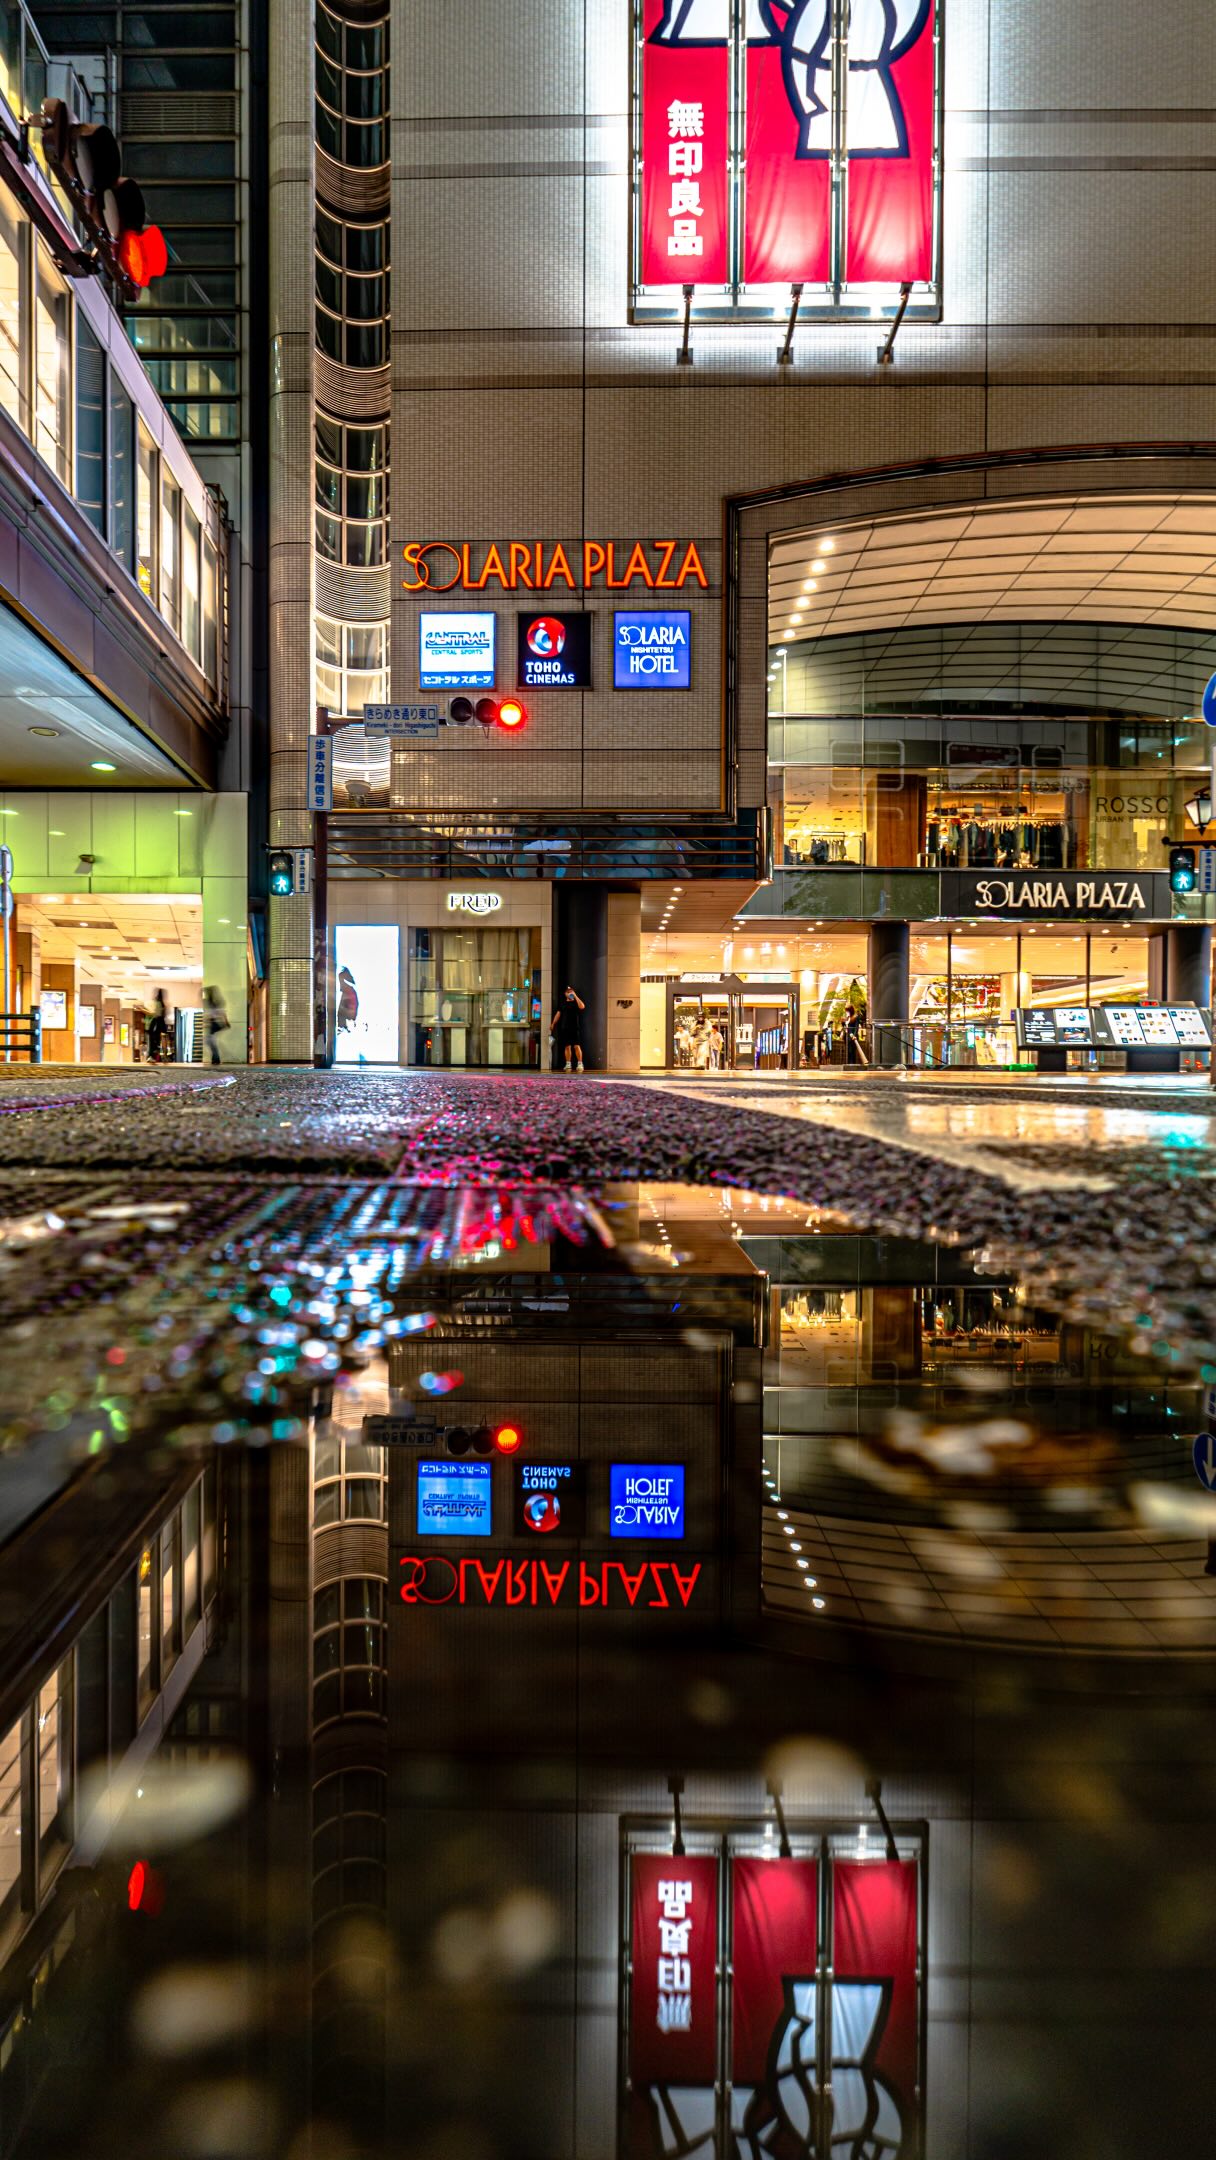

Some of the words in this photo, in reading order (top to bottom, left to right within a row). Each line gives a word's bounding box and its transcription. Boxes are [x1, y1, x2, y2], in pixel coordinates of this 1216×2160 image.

[667, 99, 704, 256] 無印良品
[402, 543, 575, 590] SOLARIA
[584, 541, 708, 588] PLAZA
[618, 625, 686, 645] SOLARIA
[526, 661, 561, 673] TOHO
[630, 655, 679, 673] HOTEL
[526, 673, 575, 684] CINEMAS
[367, 708, 436, 720] きらめき通り東口
[975, 880, 1070, 908] SOLARIA
[1076, 882, 1146, 908] PLAZA
[450, 895, 499, 912] FRED
